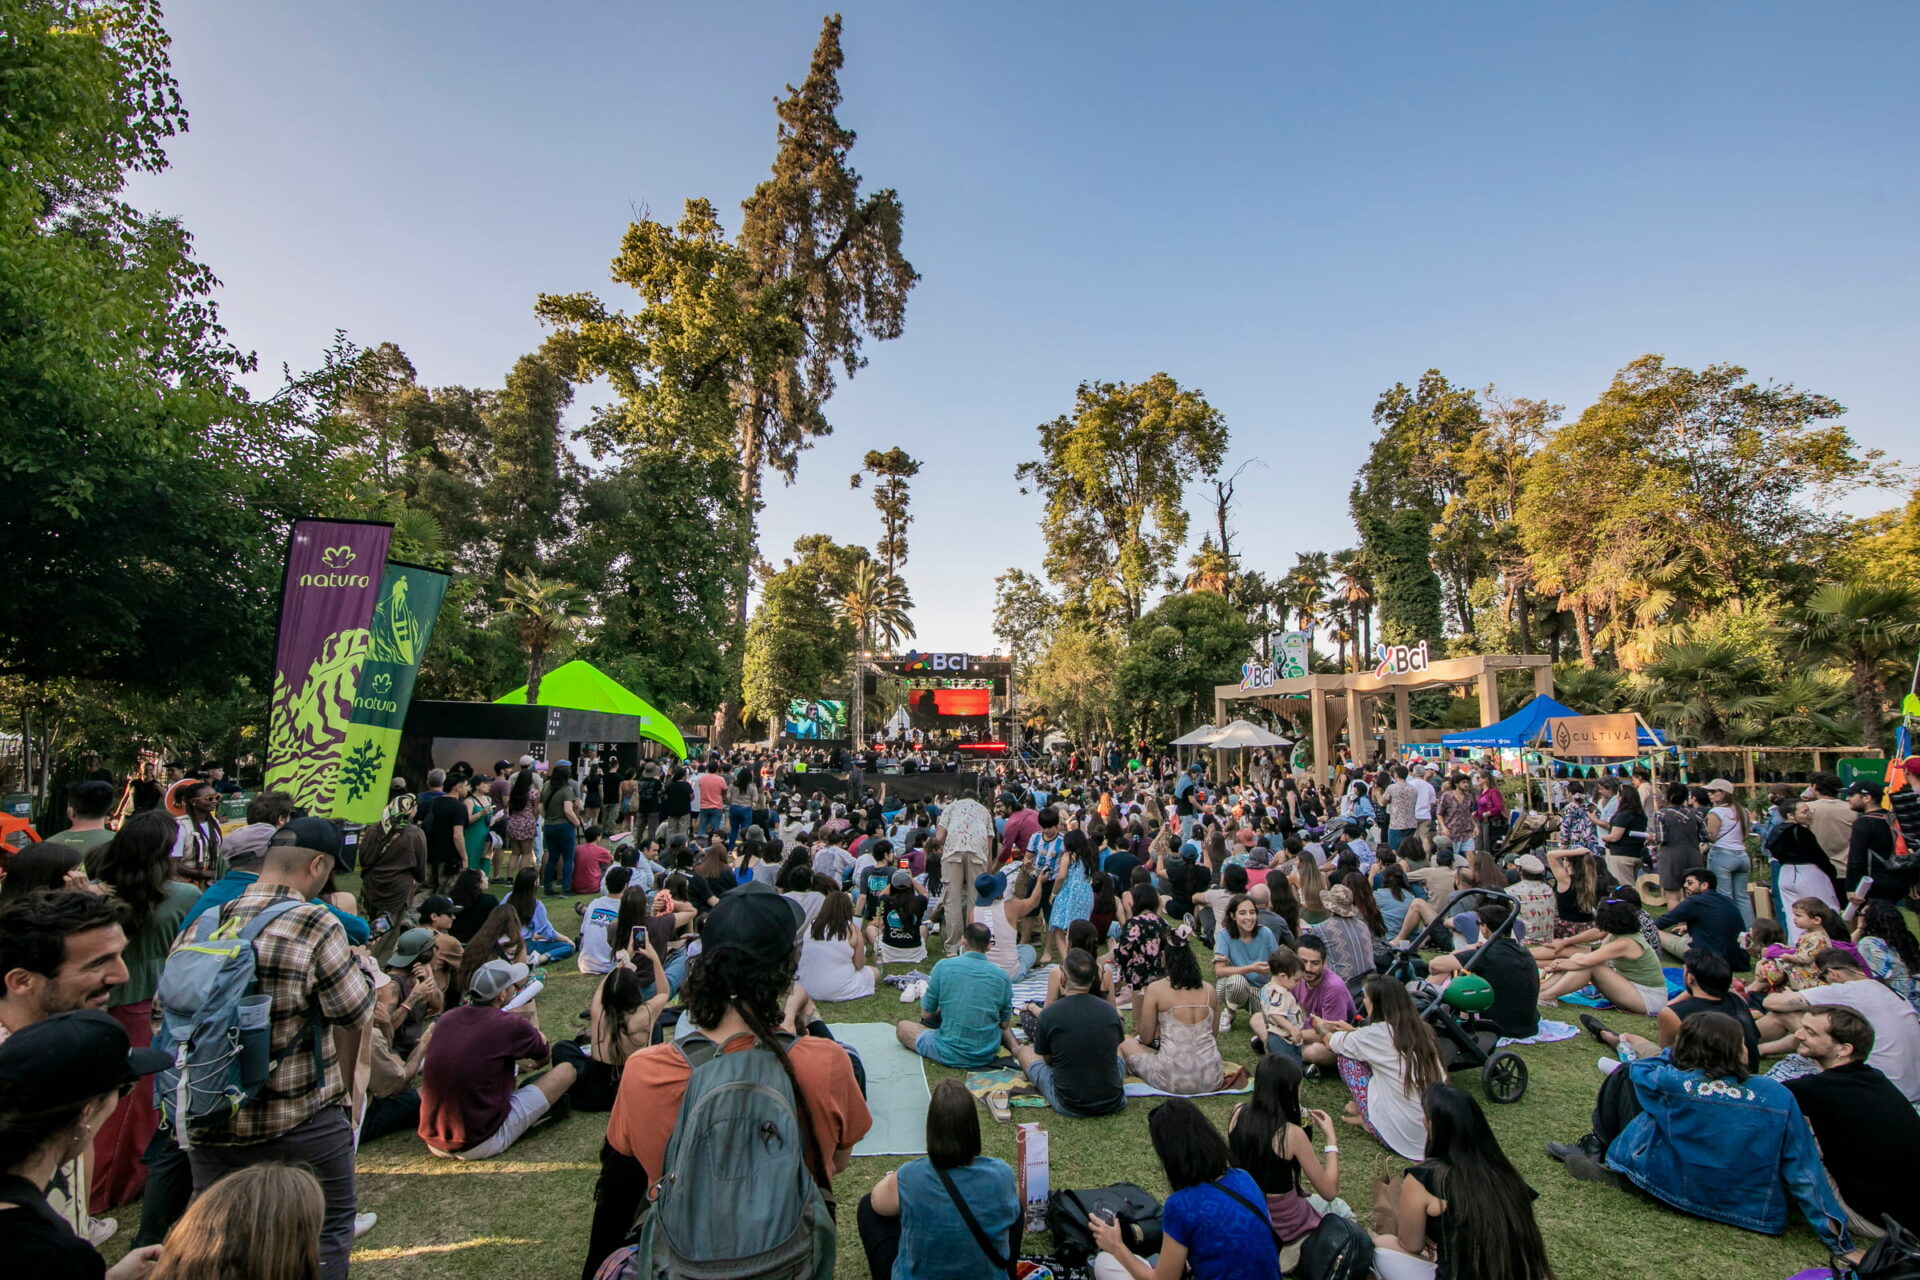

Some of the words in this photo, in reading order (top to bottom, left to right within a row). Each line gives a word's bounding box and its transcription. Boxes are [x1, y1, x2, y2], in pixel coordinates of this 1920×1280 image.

[300, 572, 369, 588] natura
[933, 652, 967, 671] Bci
[1395, 642, 1427, 673] Bci
[1254, 663, 1273, 687] Bci
[354, 696, 397, 713] natura
[1572, 731, 1631, 741] CULTIVA
